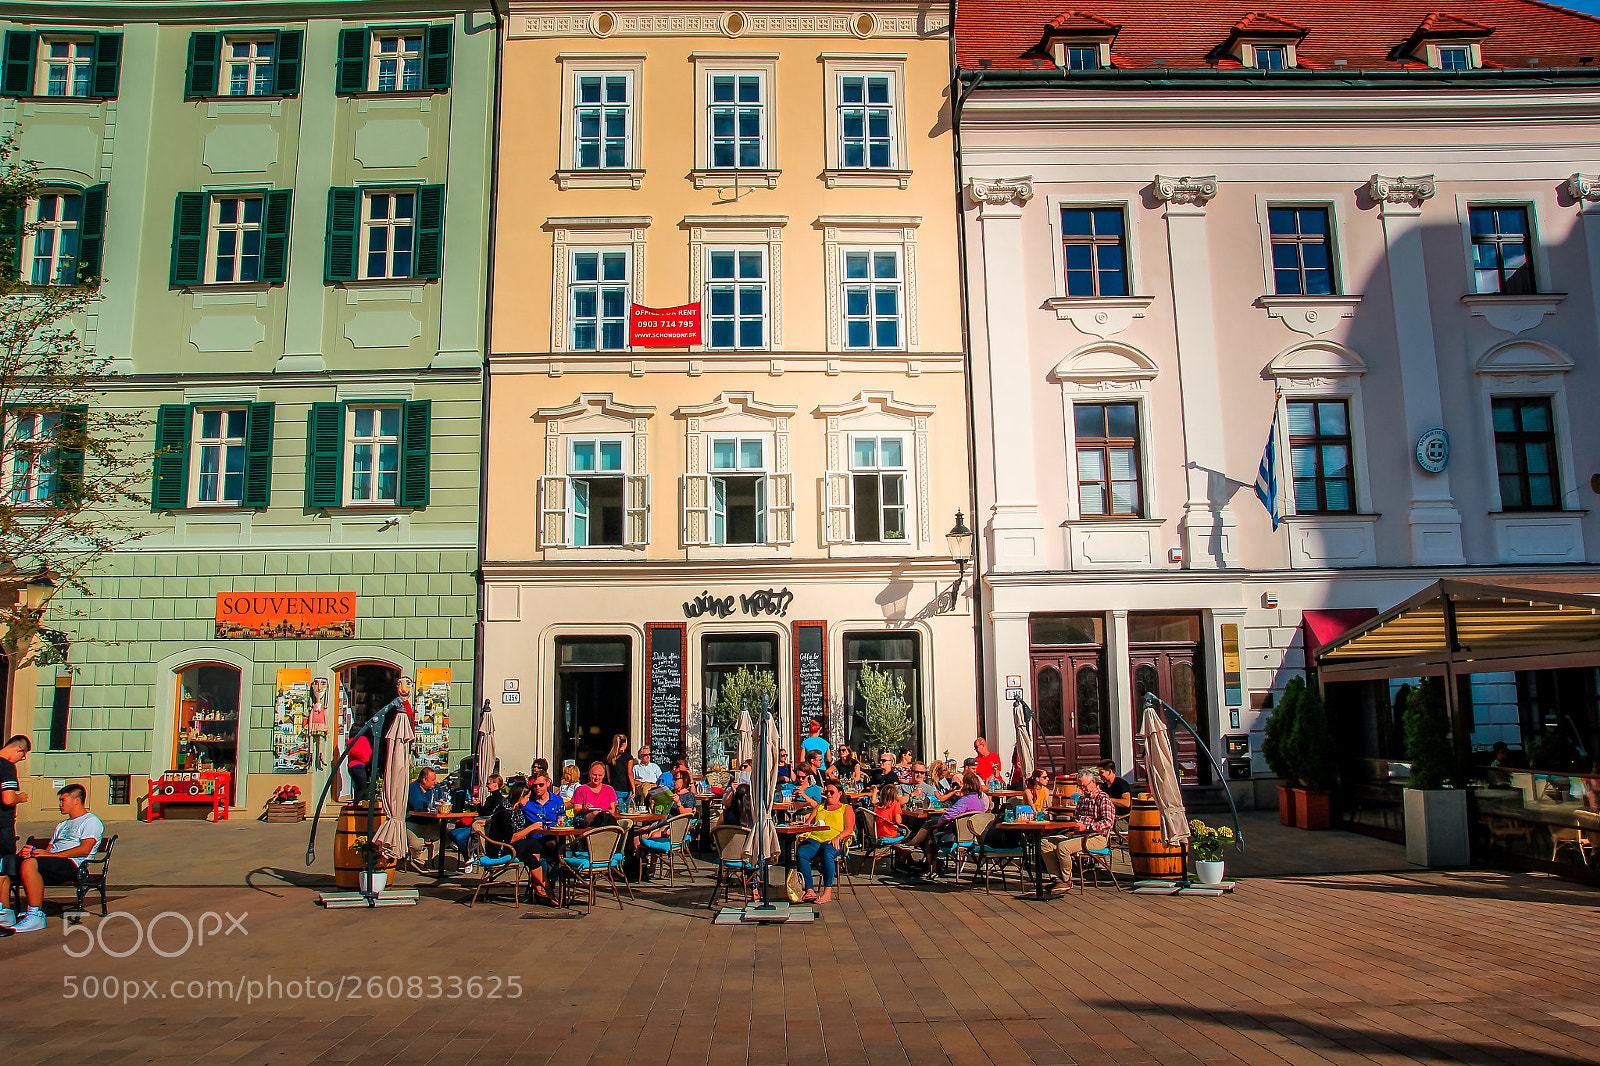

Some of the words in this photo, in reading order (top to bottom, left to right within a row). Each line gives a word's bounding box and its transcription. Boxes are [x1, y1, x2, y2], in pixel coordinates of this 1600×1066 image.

[660, 320, 676, 328] 714
[678, 320, 694, 328] 795
[222, 597, 350, 614] SOUVENIRS
